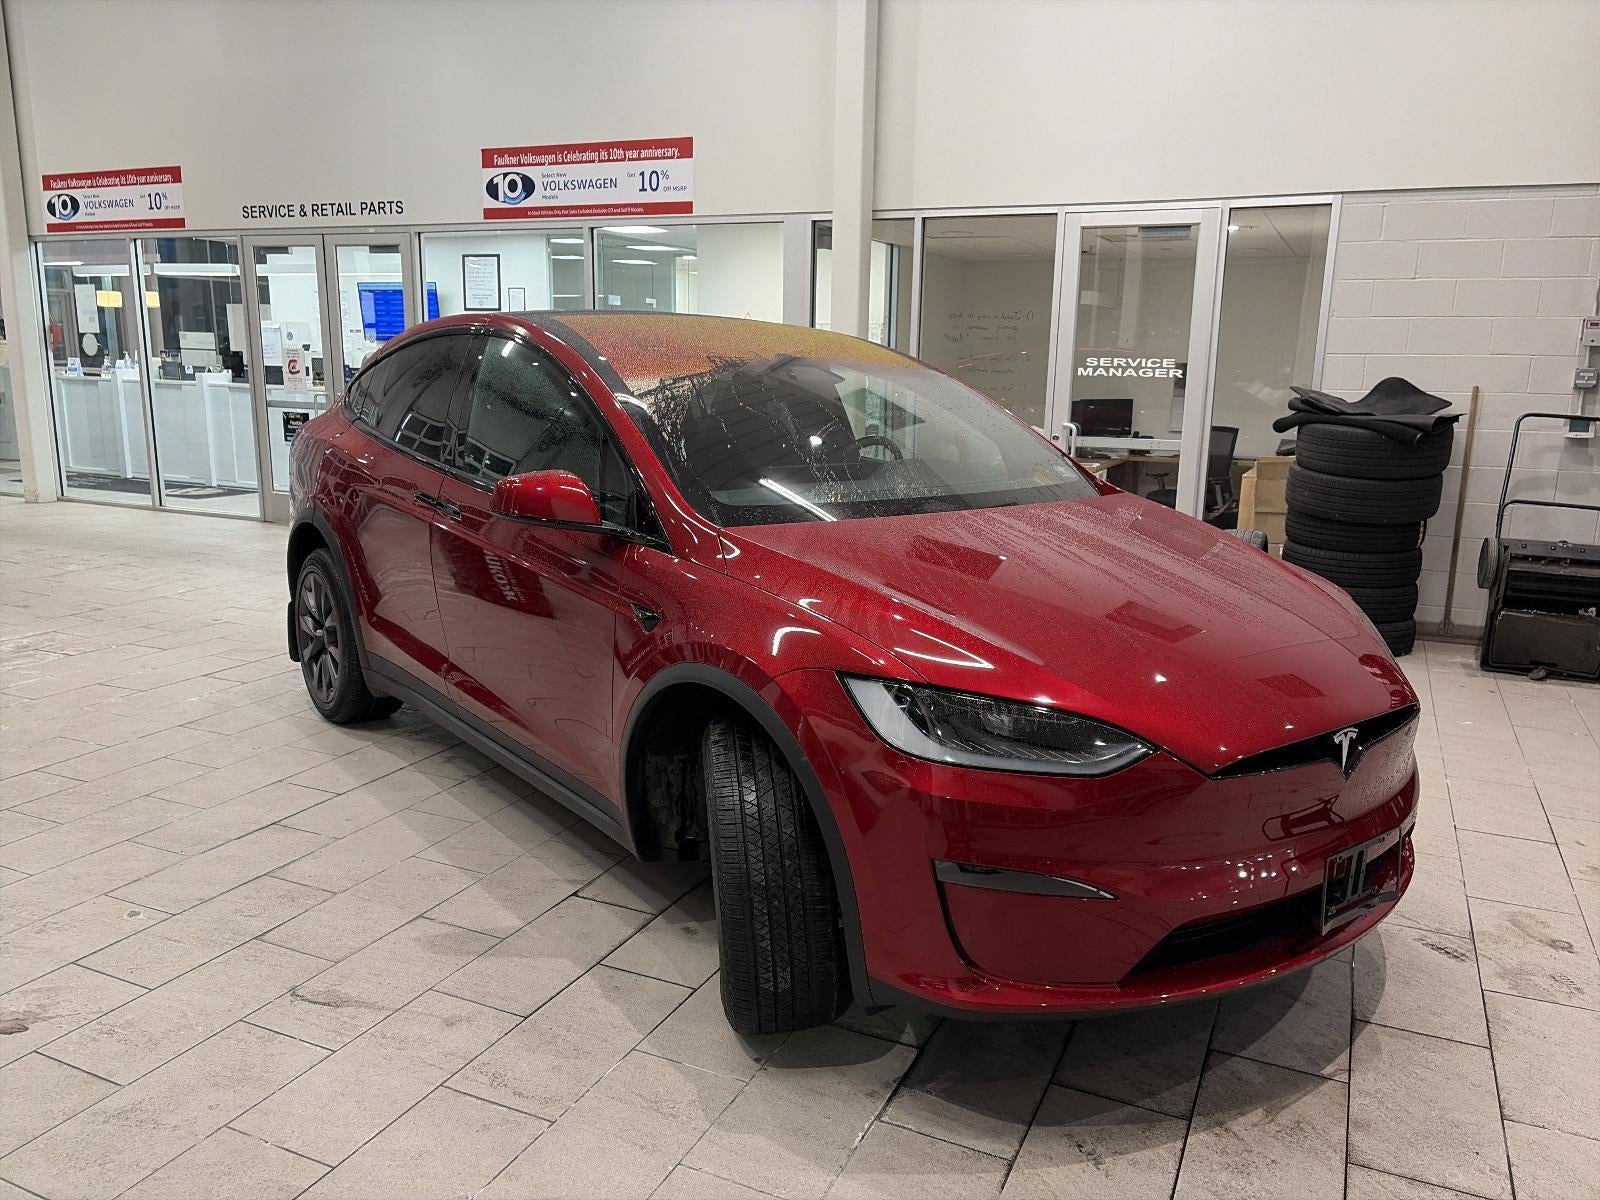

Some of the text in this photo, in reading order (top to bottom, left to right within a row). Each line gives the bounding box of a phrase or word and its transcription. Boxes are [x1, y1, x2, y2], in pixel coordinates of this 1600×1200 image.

[493, 153, 520, 166] Faulkner
[520, 149, 556, 166] Volkswagen
[557, 151, 563, 162] is
[563, 147, 599, 163] Celebrating
[609, 147, 624, 160] 10th
[625, 149, 640, 162] year
[640, 145, 680, 159] anniversary.
[493, 173, 523, 202] 10
[541, 178, 618, 192] VOLKSWAGEN
[51, 194, 72, 218] 10
[83, 198, 135, 210] VOLKSWAGEN
[242, 200, 405, 219] SERVICE & RETAIL PARTS
[1085, 357, 1177, 368] SERVICE
[1077, 367, 1184, 379] MANAGER
